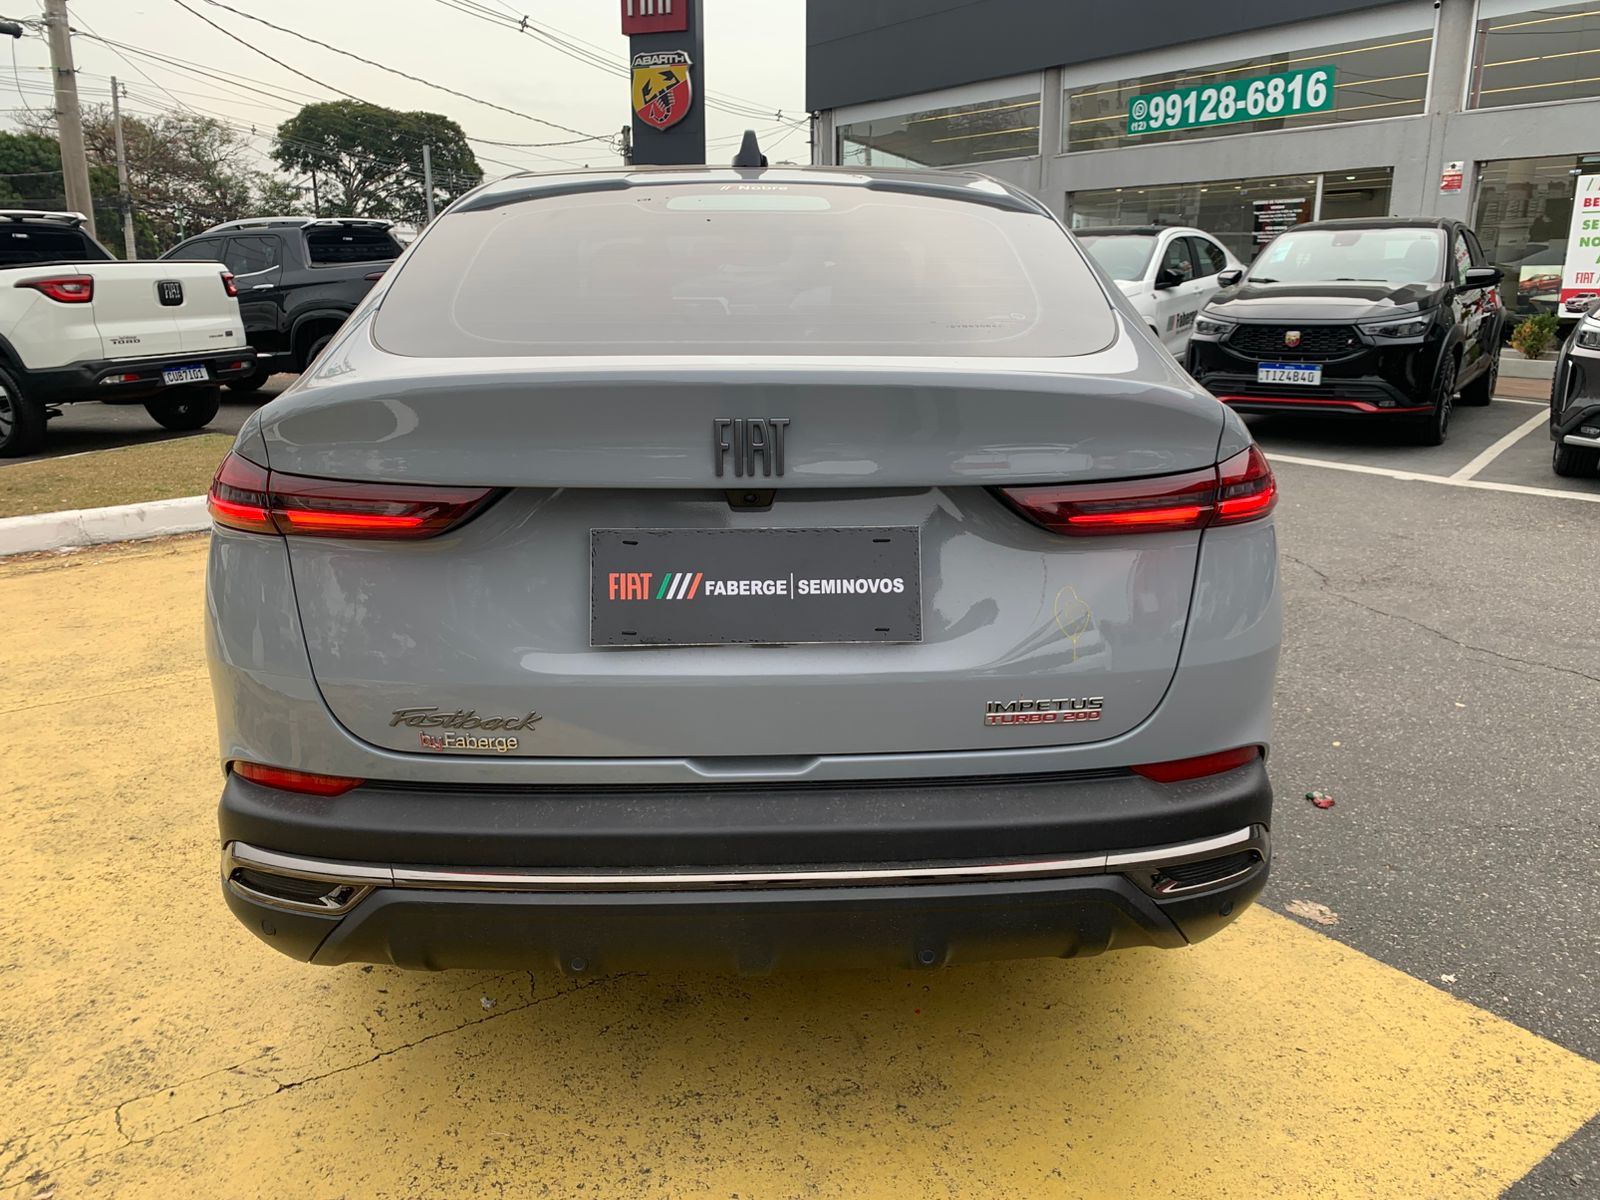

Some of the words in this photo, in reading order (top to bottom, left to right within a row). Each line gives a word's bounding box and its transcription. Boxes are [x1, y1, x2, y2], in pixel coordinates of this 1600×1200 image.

[634, 54, 685, 66] ABARTH
[1131, 121, 1147, 131] (12)
[1150, 71, 1328, 128] 99128-6816
[1575, 272, 1595, 285] FIAT
[714, 418, 790, 477] FIAT
[608, 573, 653, 600] FIAT
[705, 579, 787, 596] FABERGE
[797, 577, 905, 594] SEMINOVOS
[986, 696, 1104, 713] IMPETUS
[388, 706, 543, 731] Fastback
[986, 712, 1057, 725] TURBO
[1063, 710, 1101, 722] 200
[419, 731, 443, 751] by
[443, 731, 518, 752] Faberge
